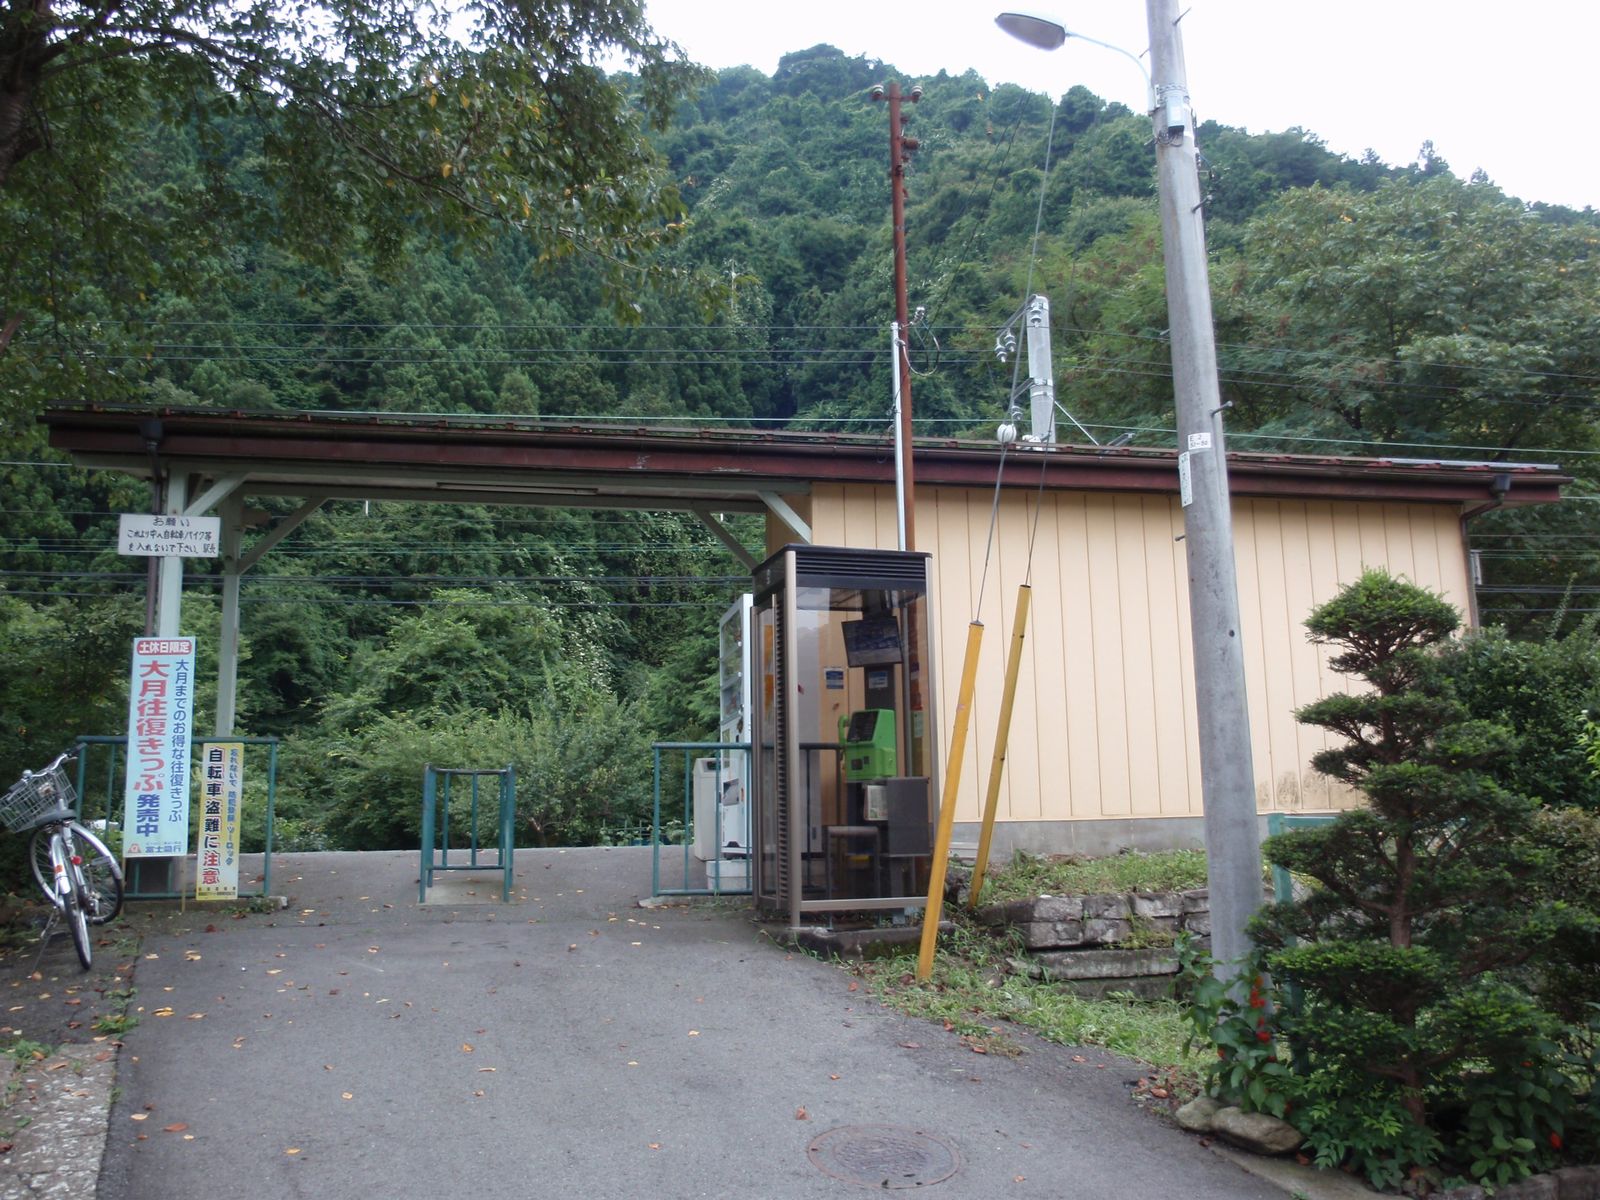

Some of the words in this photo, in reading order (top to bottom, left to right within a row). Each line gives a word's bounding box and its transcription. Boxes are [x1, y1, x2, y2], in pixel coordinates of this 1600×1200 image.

[152, 516, 190, 527] お願い
[139, 641, 190, 654] 土休日限定
[169, 660, 189, 822] 大月までのお得な往復きっぷ
[202, 748, 224, 885] 自転車盗難に注意
